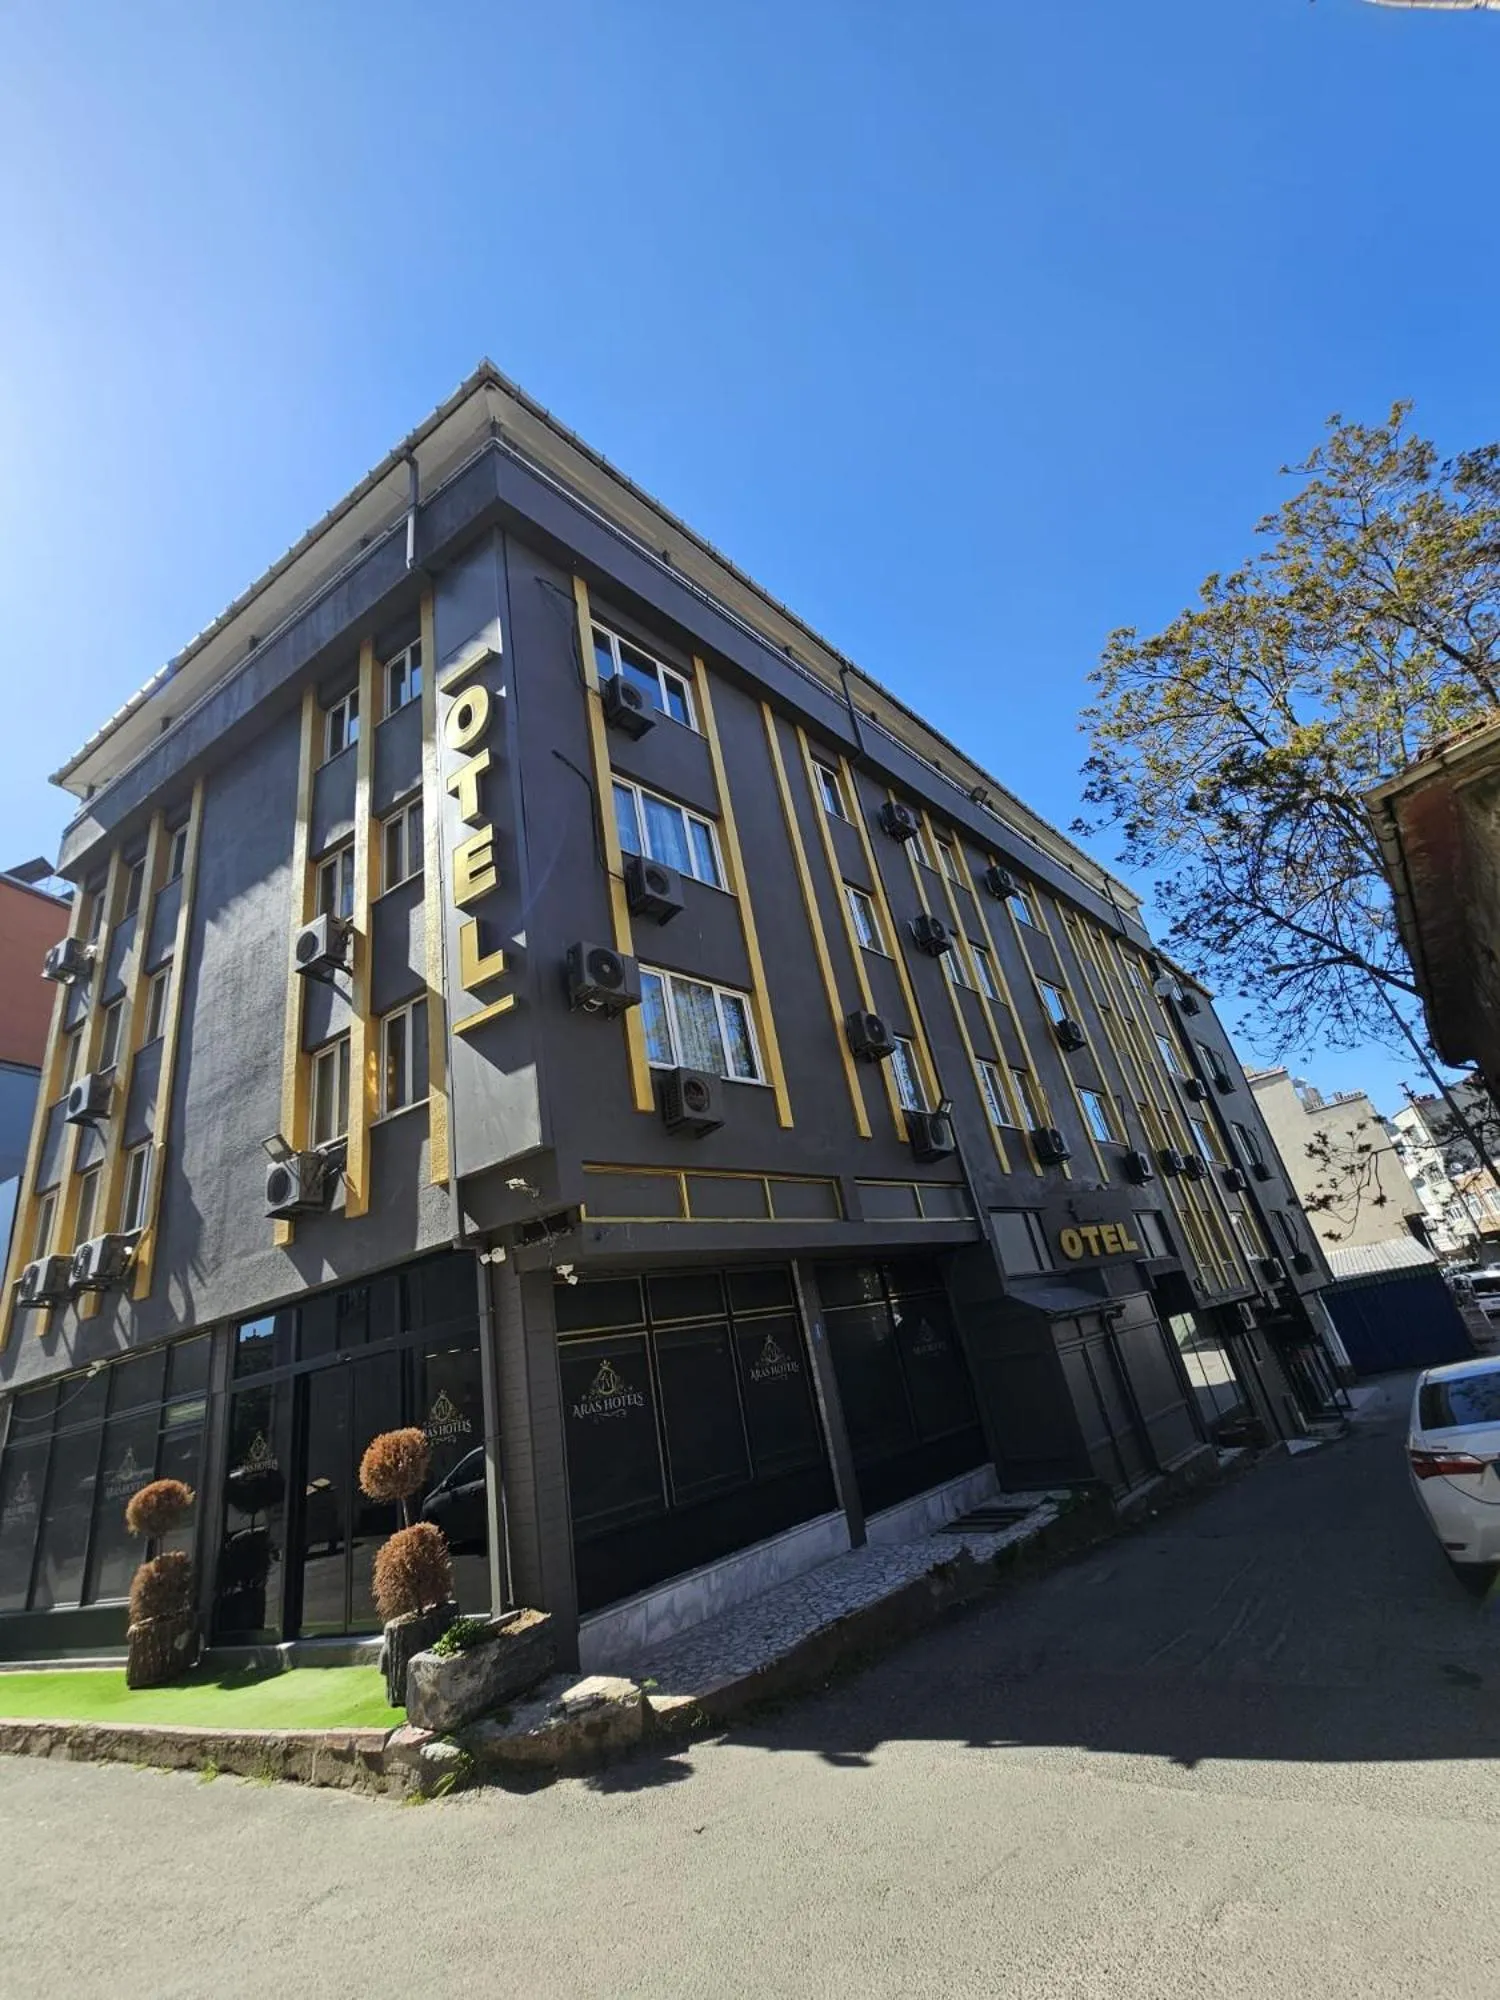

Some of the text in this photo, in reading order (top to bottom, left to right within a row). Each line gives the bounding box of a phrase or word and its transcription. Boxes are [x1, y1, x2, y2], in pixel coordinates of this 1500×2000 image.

[445, 684, 506, 991] OTEL
[1059, 1223, 1140, 1260] OTEL
[572, 1392, 646, 1419] ARAS HOTELS
[439, 1418, 472, 1436] HOTELS
